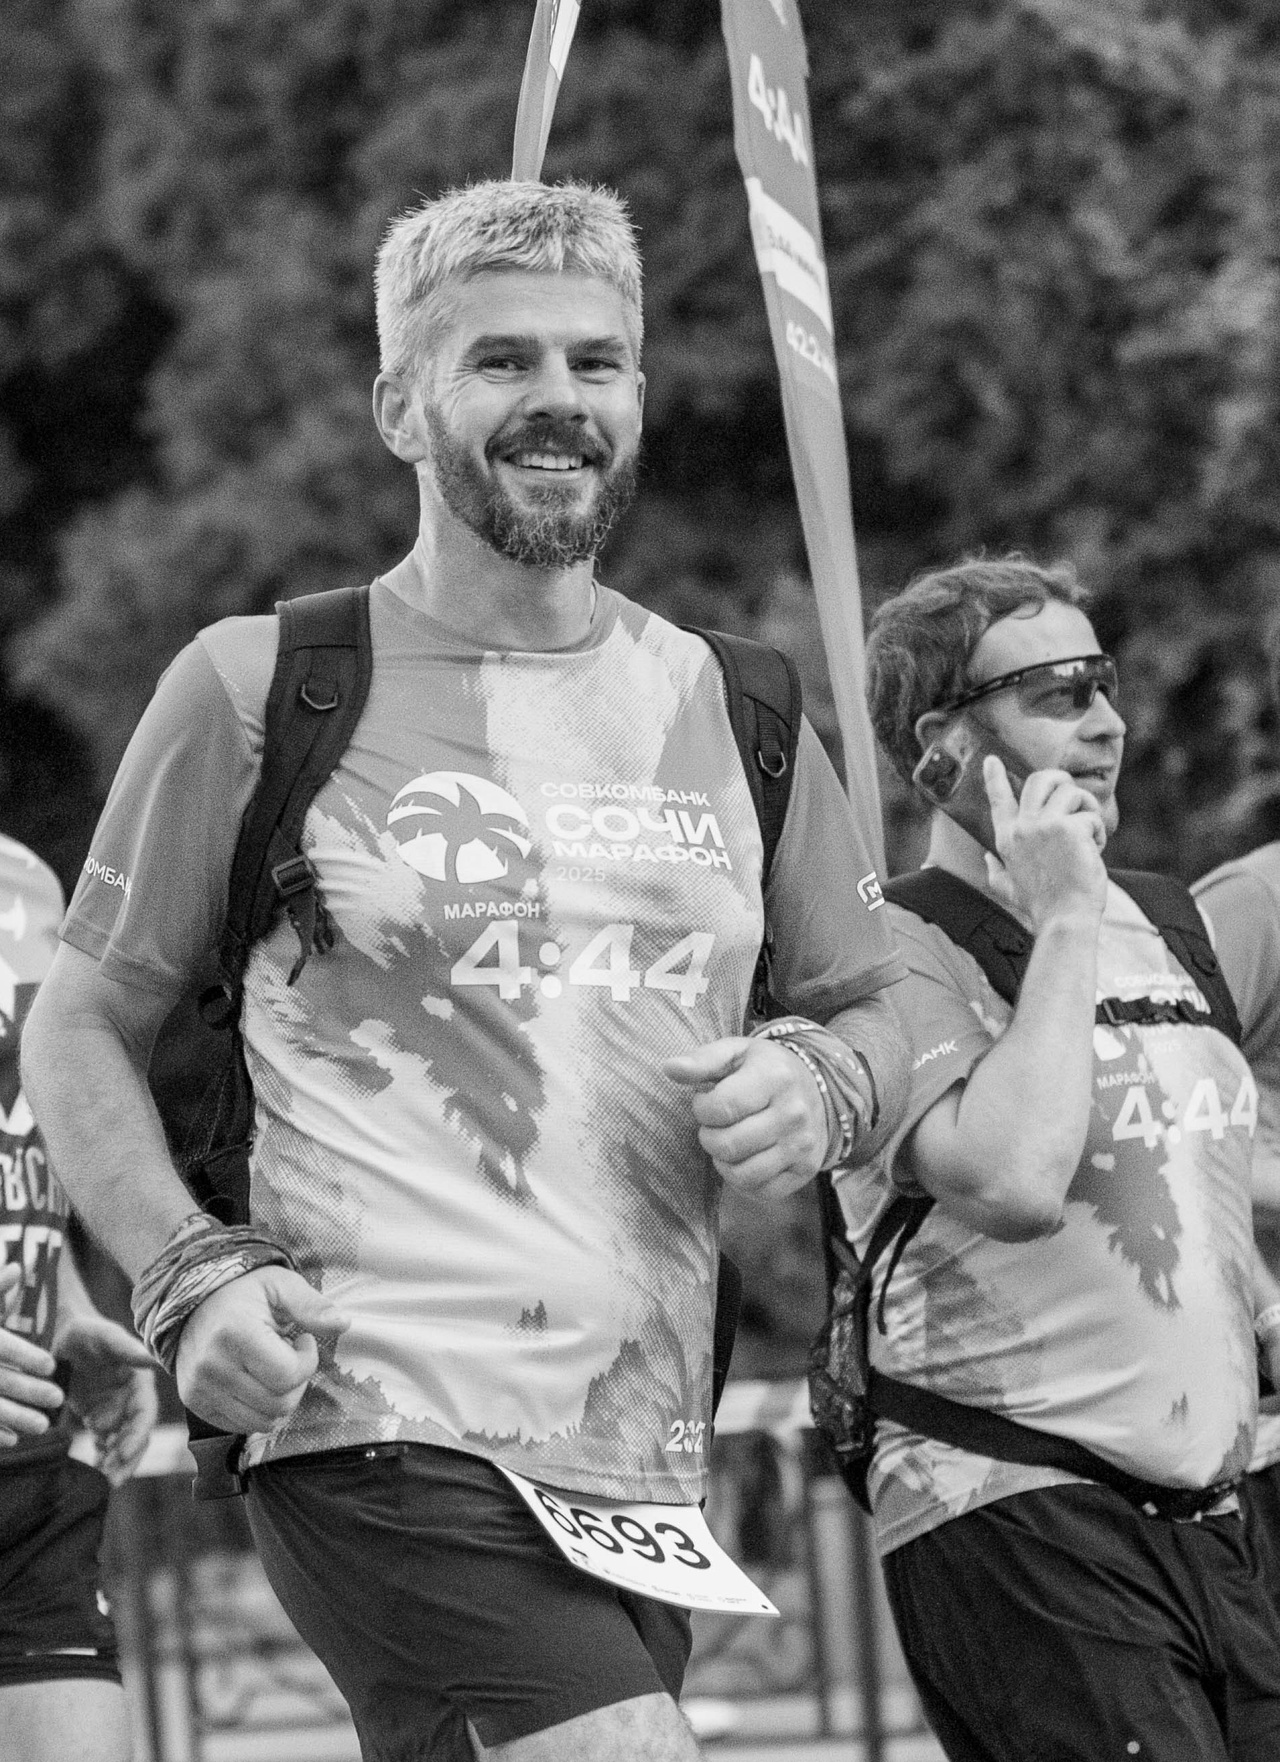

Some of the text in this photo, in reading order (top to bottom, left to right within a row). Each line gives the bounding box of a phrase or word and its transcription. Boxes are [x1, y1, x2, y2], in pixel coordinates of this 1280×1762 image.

[540, 782, 712, 808] СОВКОМБАНК
[545, 803, 725, 849] СОЧИ
[552, 840, 733, 871] МАРАФОН
[556, 866, 607, 883] 2025
[443, 903, 541, 920] МАРАФОН
[450, 919, 717, 1008] 4:44
[1111, 1077, 1258, 1148] 4:44
[533, 1488, 712, 1570] 6693
